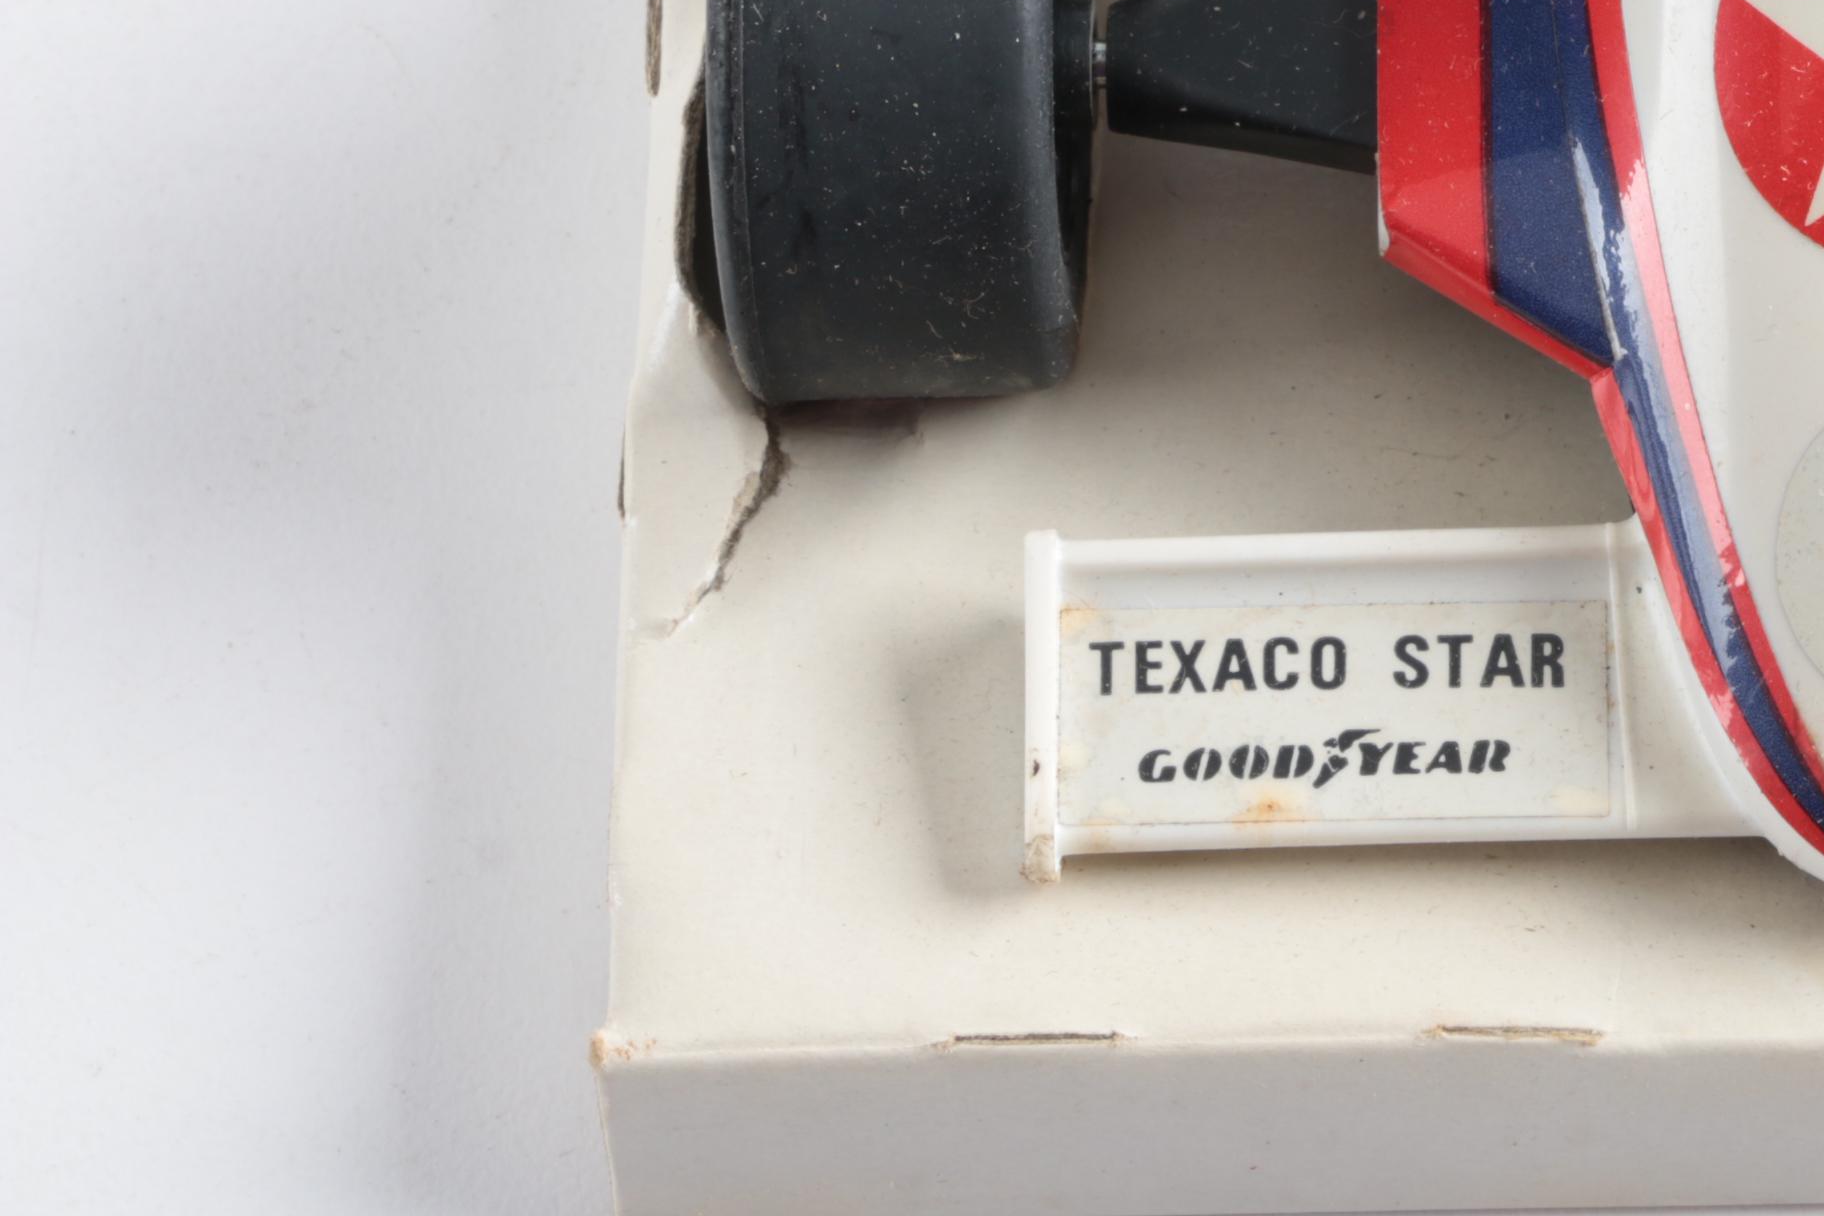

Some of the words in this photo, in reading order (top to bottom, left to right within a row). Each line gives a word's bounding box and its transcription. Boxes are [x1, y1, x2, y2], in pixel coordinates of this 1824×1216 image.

[1090, 636, 1347, 696] TEXACO
[1393, 633, 1566, 689] STAR
[1137, 728, 1512, 789] GOODYEAR
